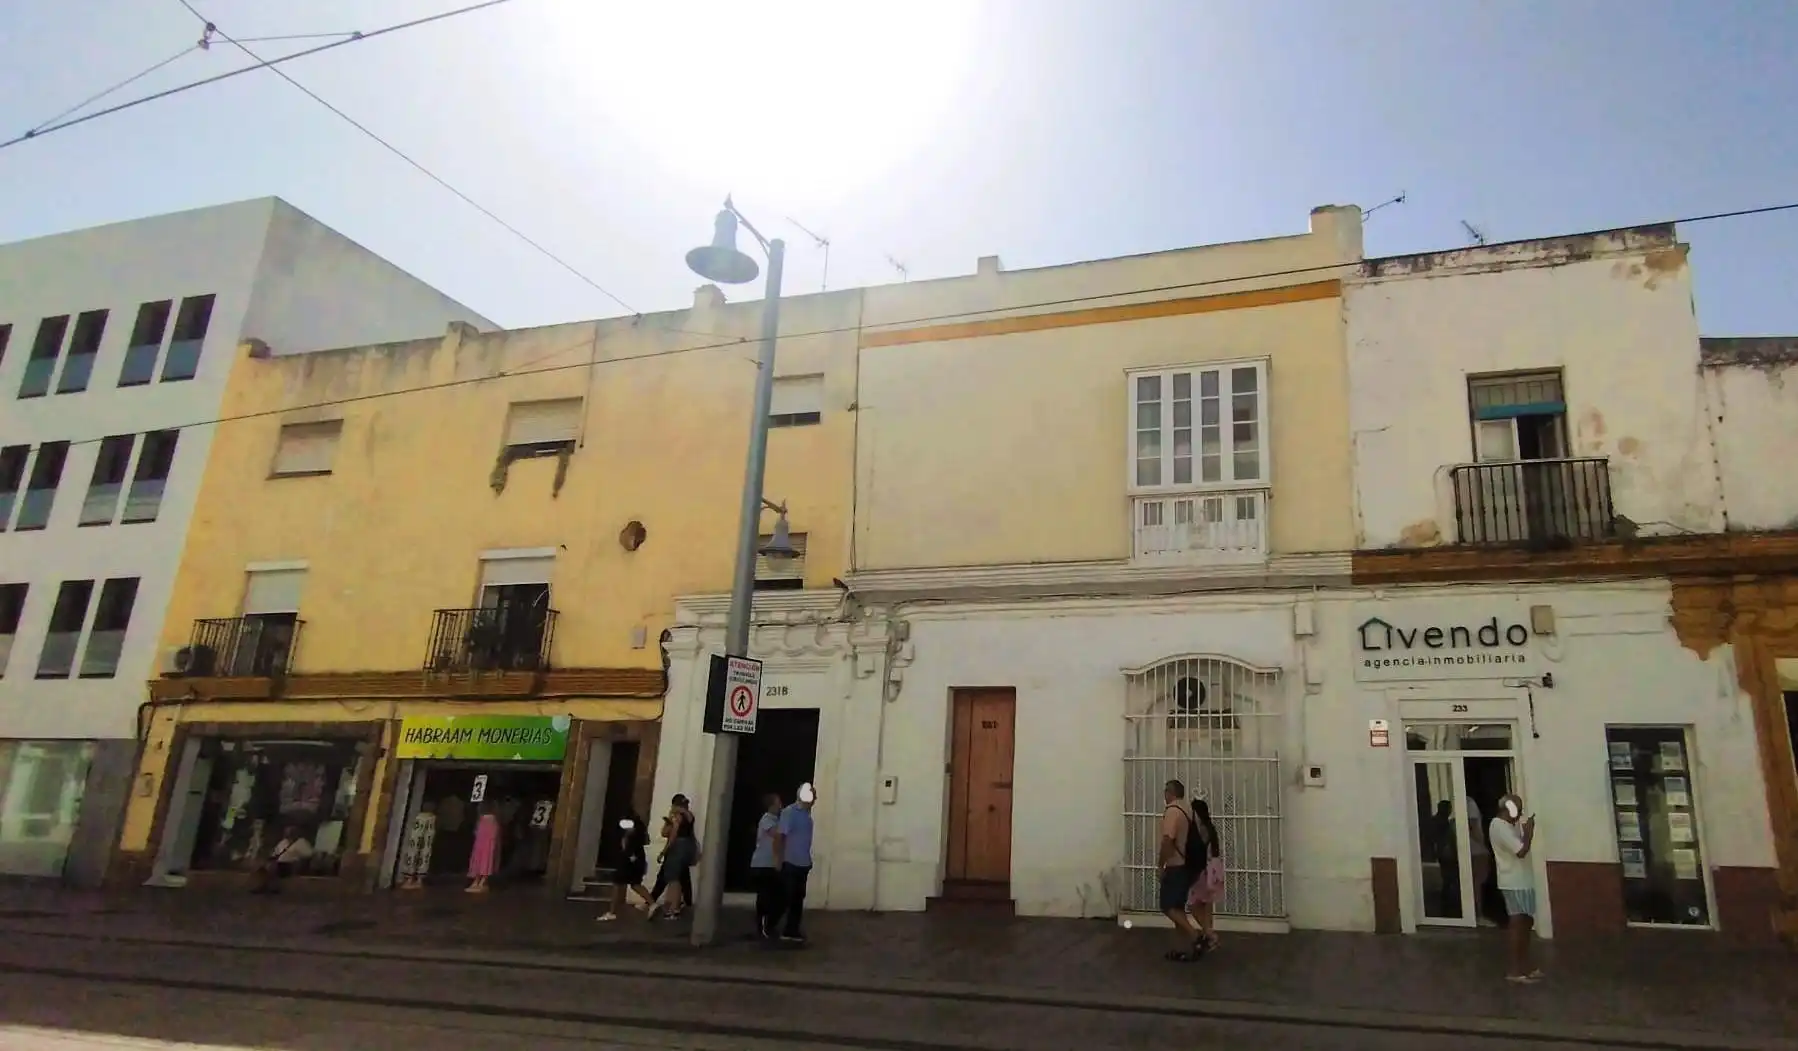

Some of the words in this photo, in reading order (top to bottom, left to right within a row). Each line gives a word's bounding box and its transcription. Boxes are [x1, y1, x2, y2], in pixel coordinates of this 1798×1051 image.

[1358, 617, 1528, 650] Livendo
[766, 686, 788, 696] 231B
[1453, 704, 1468, 713] 233
[404, 727, 473, 744] HABRAAM
[477, 727, 552, 744] MONERIAS
